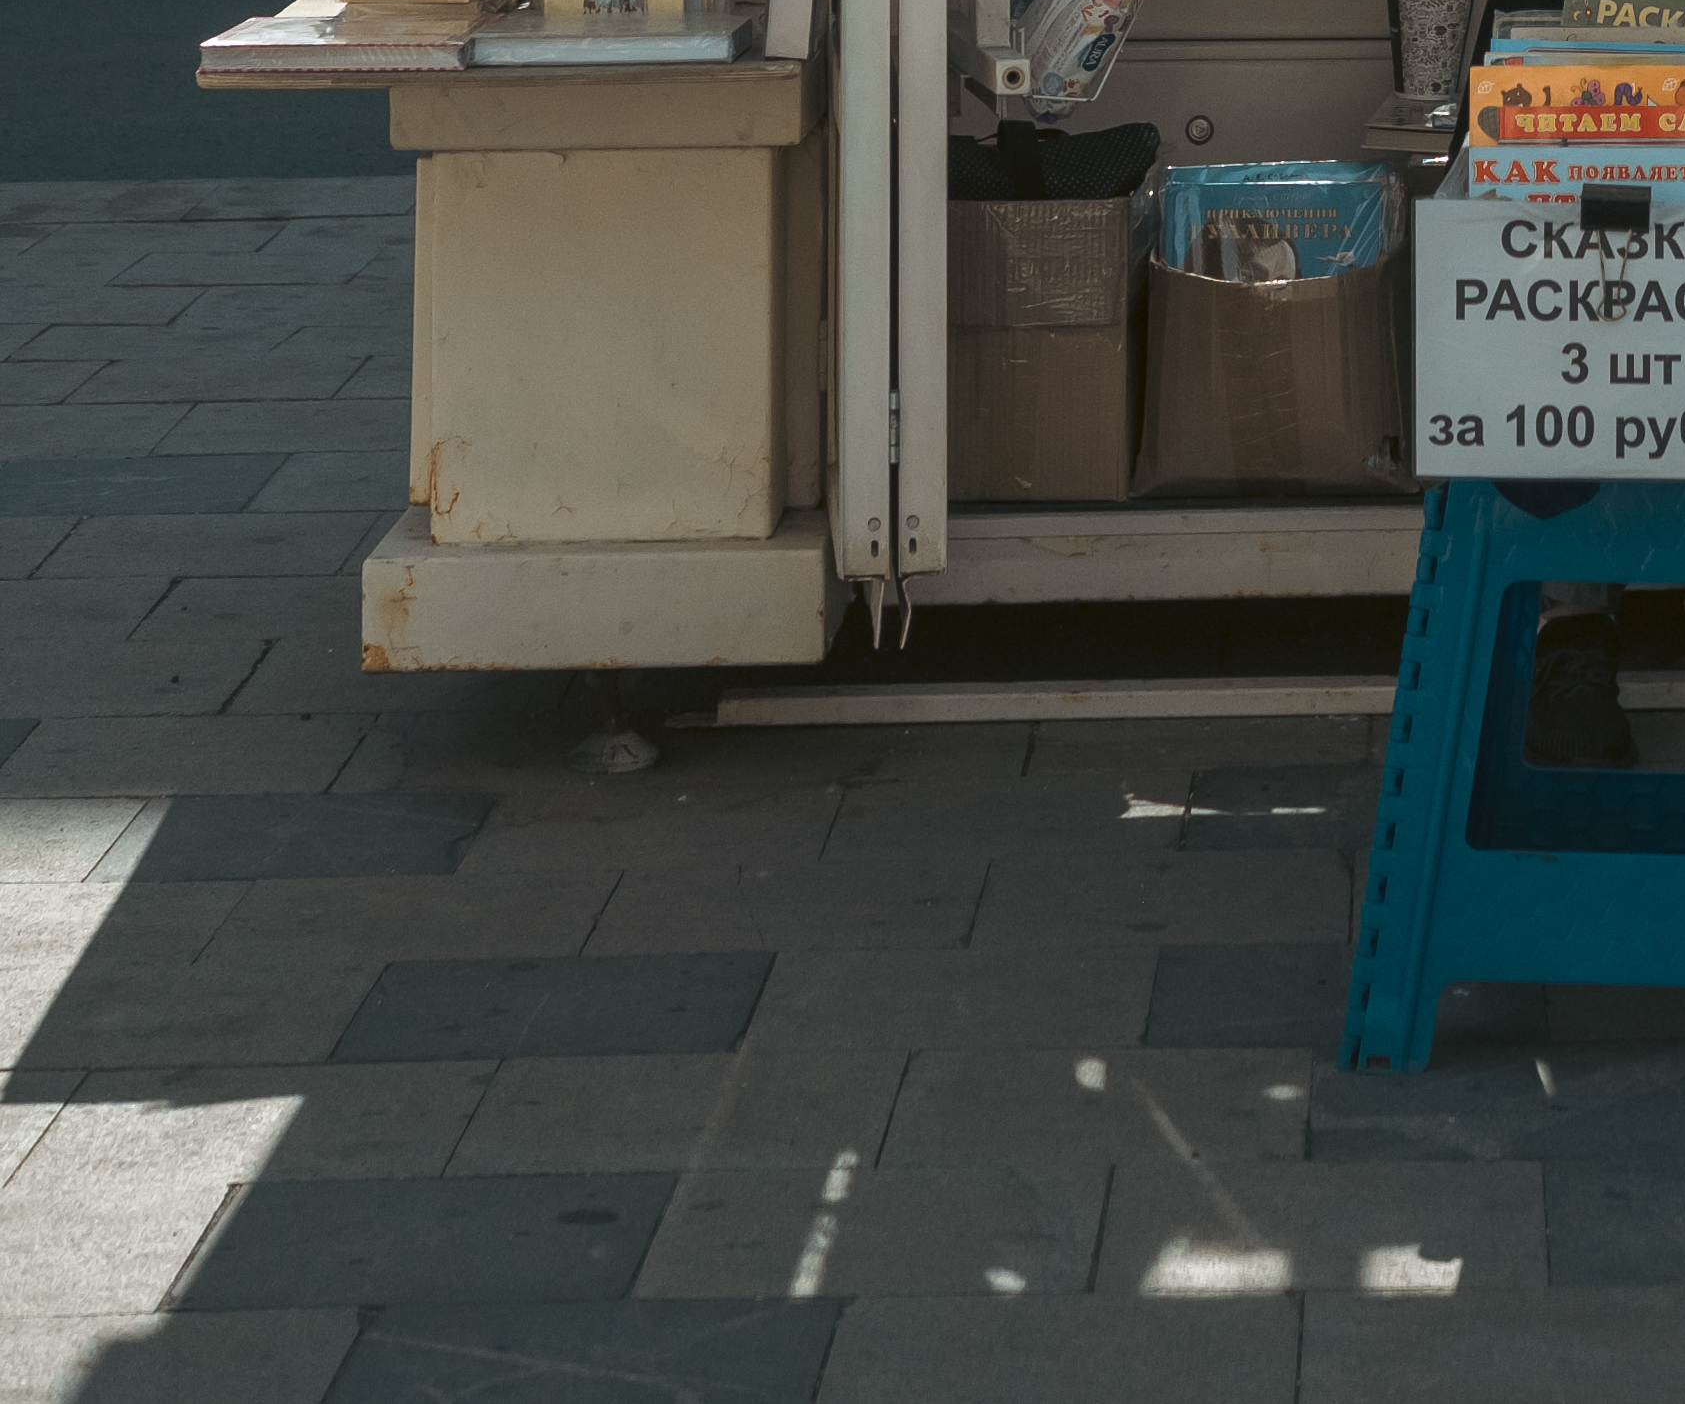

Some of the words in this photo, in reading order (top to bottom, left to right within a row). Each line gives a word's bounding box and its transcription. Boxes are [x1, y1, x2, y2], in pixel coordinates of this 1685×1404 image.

[1082, 34, 1110, 69] AURA
[1515, 112, 1643, 134] ЧИТАЕМ
[1473, 159, 1561, 185] КАК
[1205, 208, 1338, 220] ПРИКЛЮЧЕНИЯ
[1561, 342, 1589, 385] 3
[1609, 353, 1682, 385] шт
[1428, 413, 1485, 447] за
[1505, 404, 1595, 448] 100
